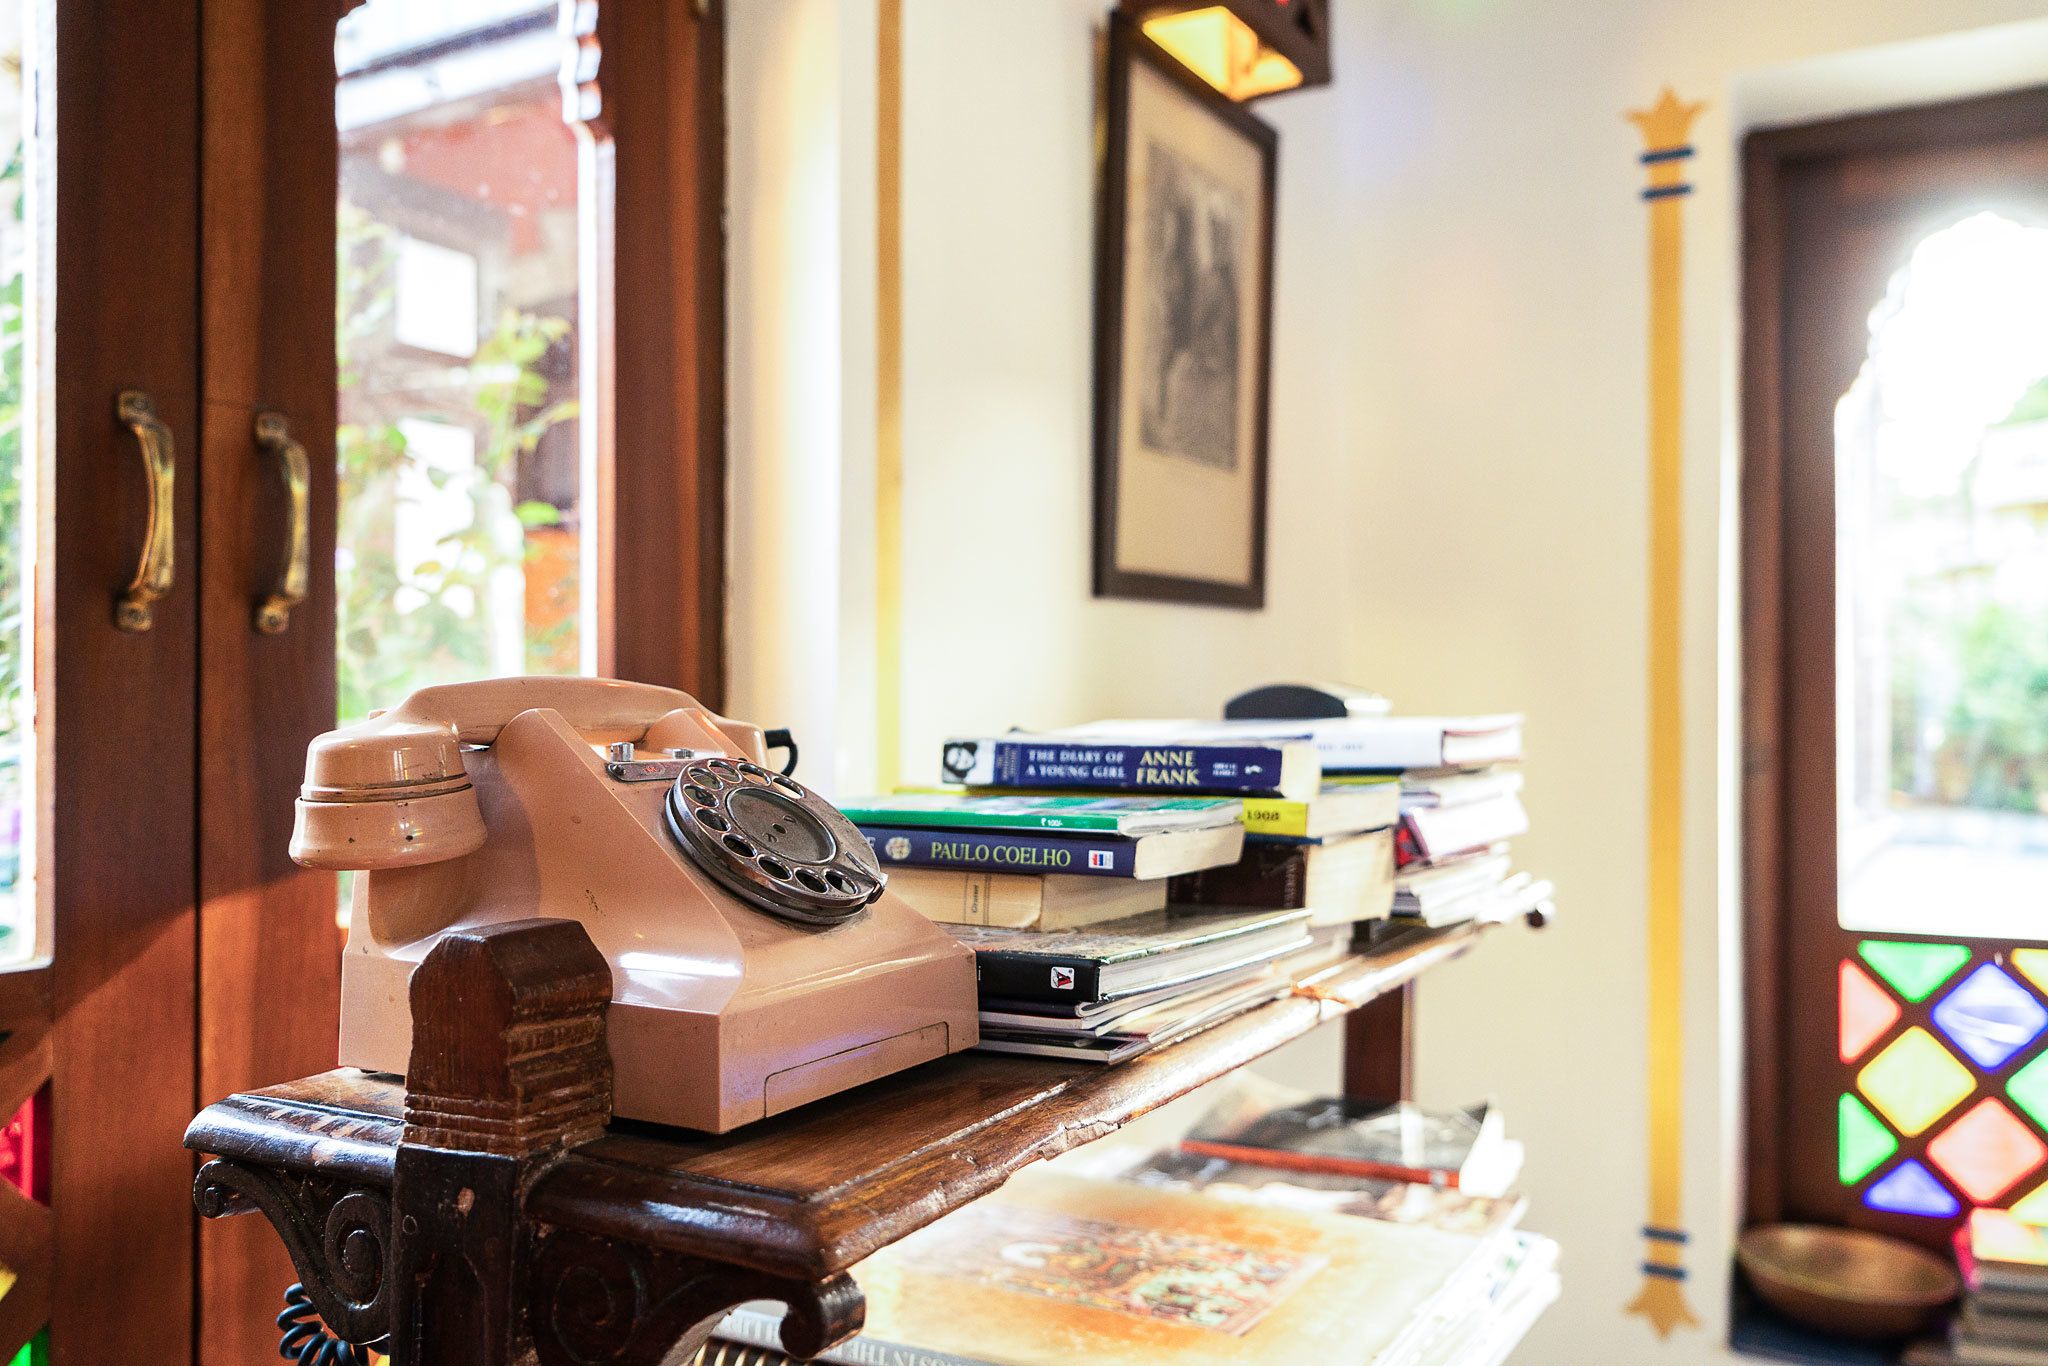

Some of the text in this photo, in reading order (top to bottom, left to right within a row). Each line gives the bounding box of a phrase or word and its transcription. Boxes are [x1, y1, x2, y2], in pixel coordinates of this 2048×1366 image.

[1028, 750, 1125, 765] THE DIARY OF
[1140, 749, 1197, 767] ANNE
[1040, 765, 1090, 779] YOUNG
[1092, 766, 1126, 779] GIRL
[1136, 767, 1200, 786] FRANK
[931, 841, 1072, 868] PAULO COELHO
